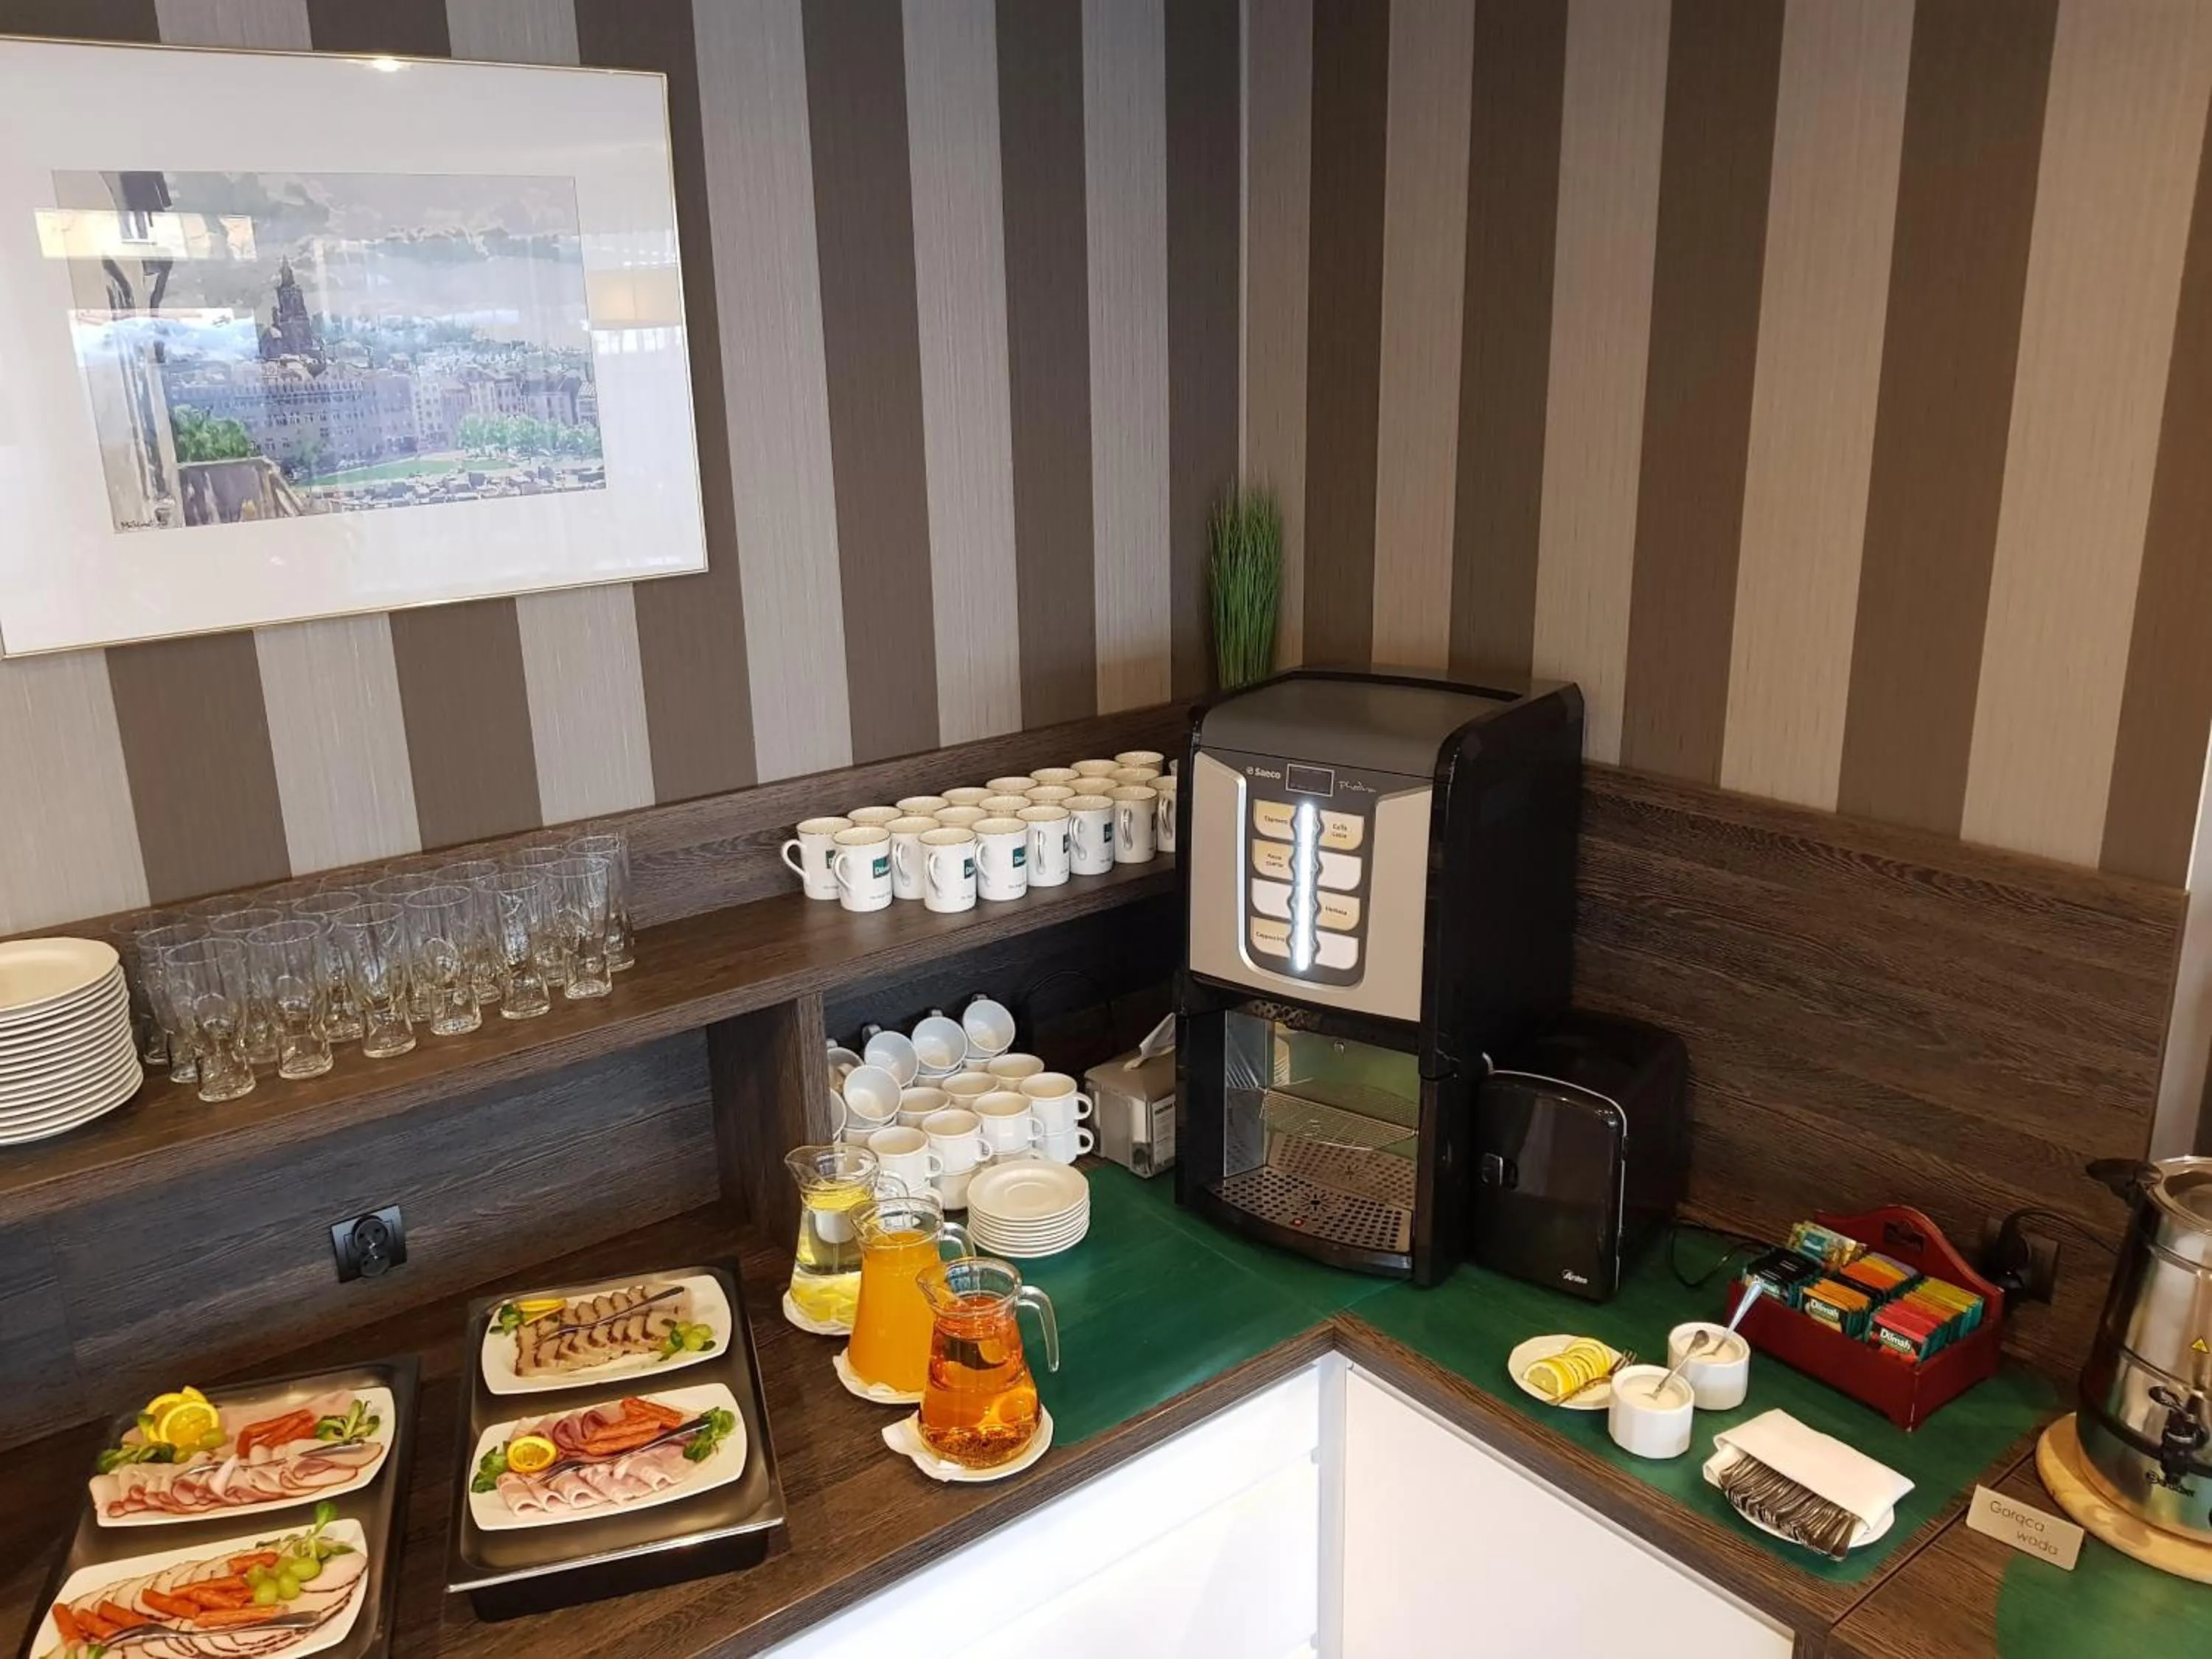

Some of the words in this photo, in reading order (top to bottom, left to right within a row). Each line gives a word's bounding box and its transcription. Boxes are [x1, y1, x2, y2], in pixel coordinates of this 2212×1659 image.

[1255, 767, 1281, 779] Saeco
[1880, 1327, 1912, 1350] Dilmah
[2016, 1531, 2058, 1555] woda
